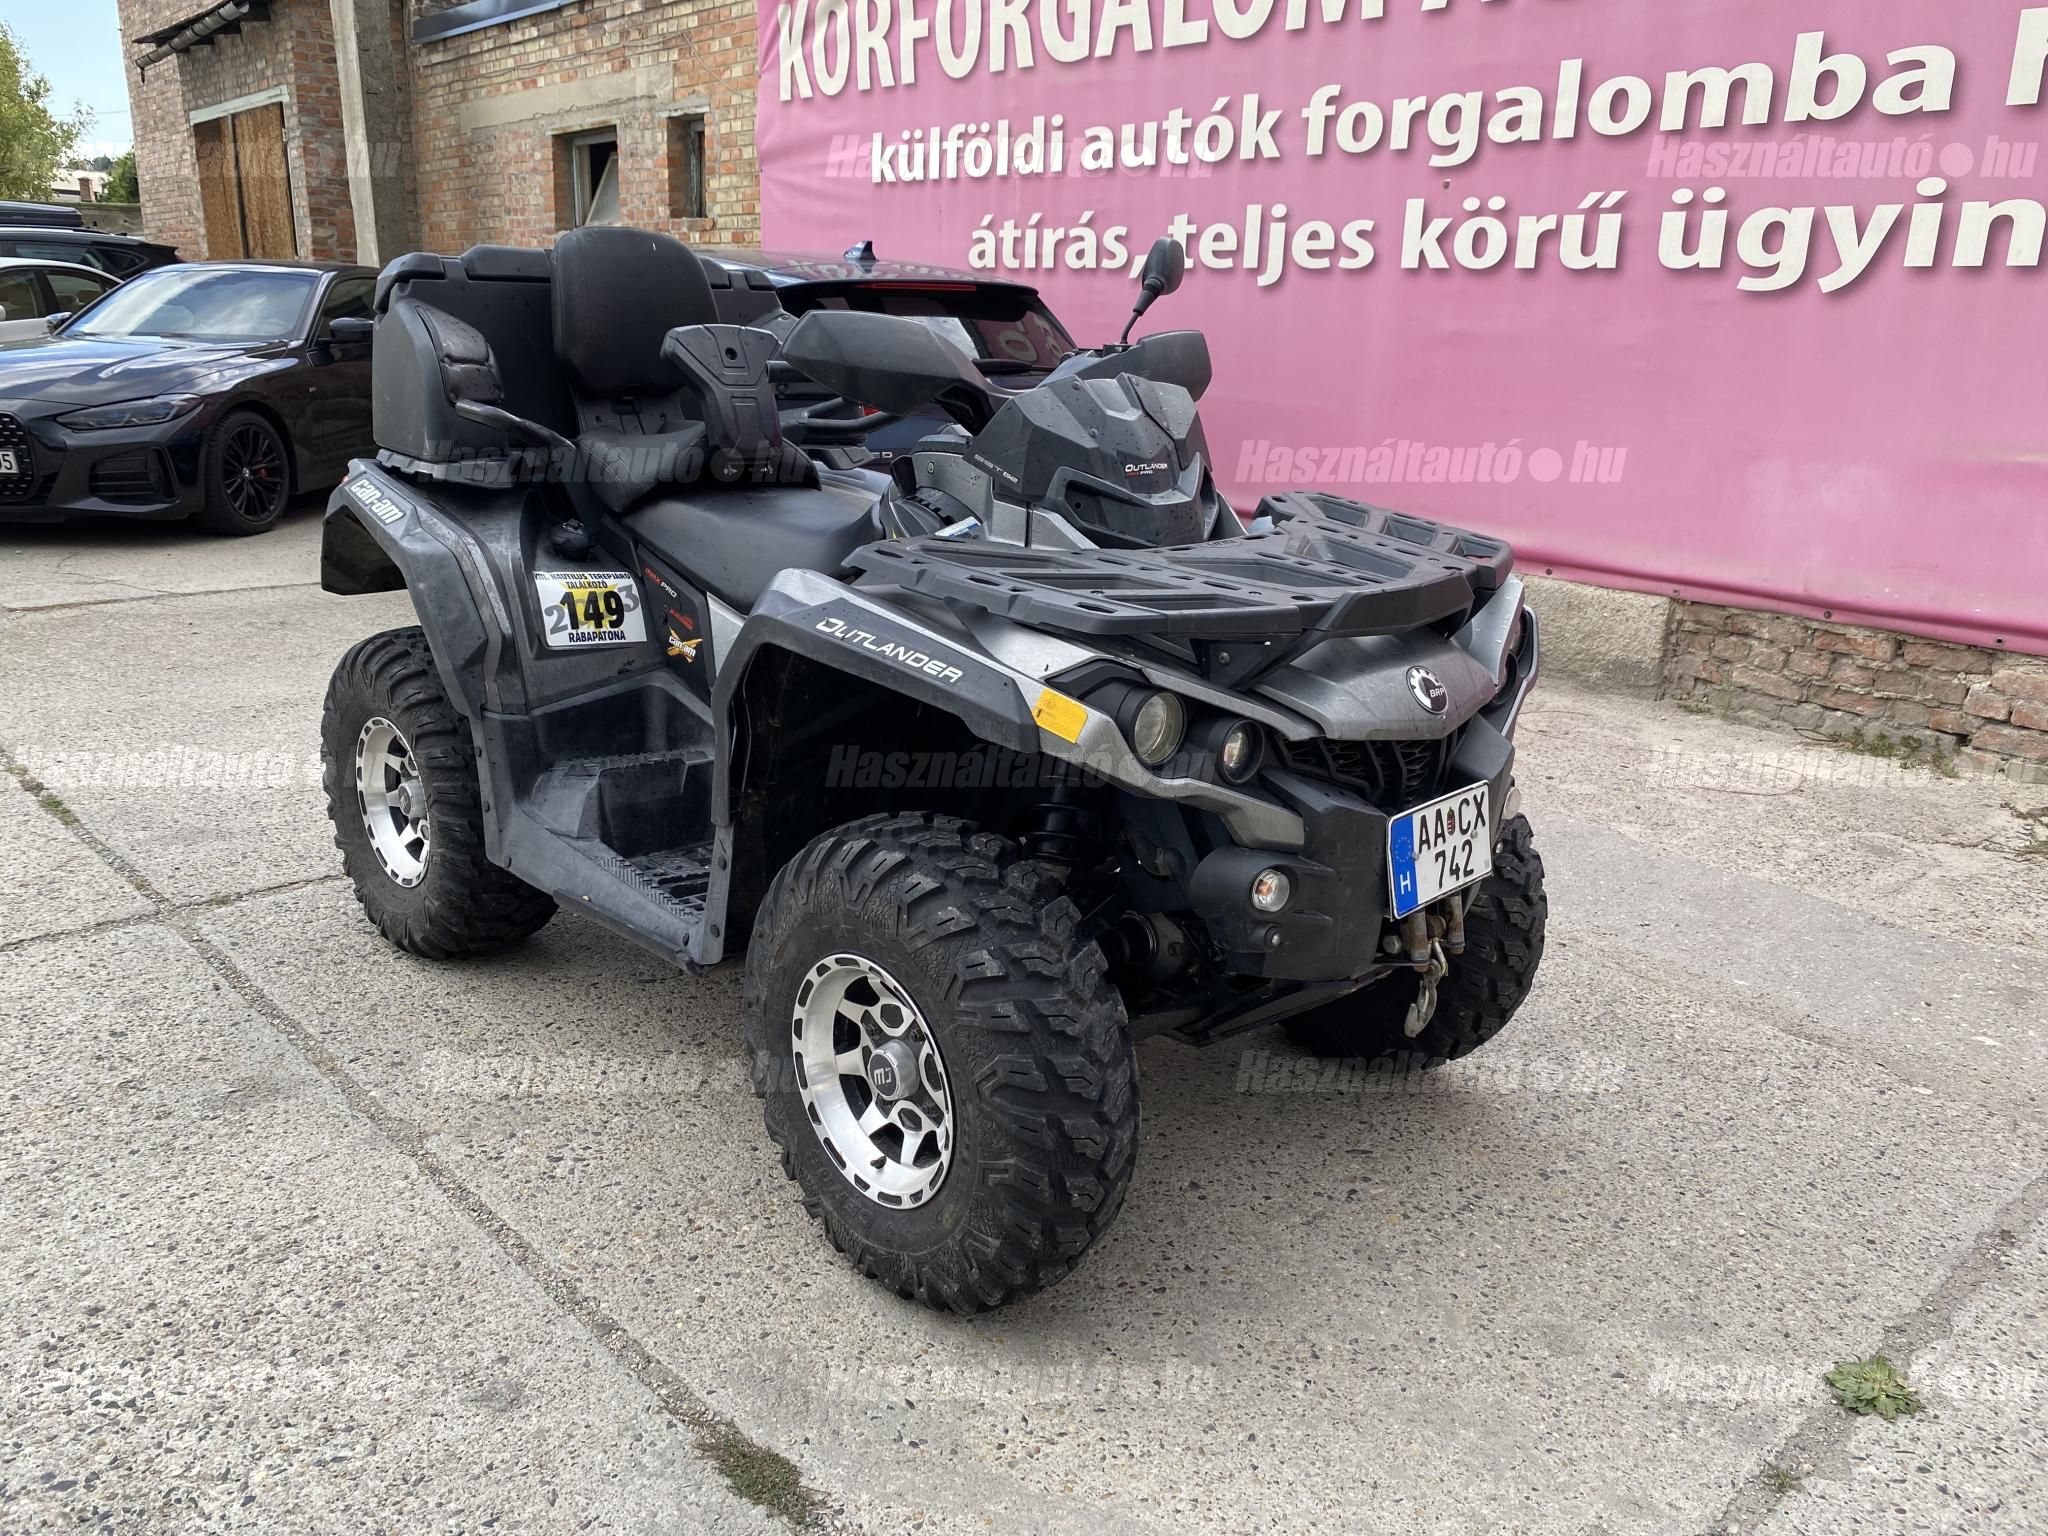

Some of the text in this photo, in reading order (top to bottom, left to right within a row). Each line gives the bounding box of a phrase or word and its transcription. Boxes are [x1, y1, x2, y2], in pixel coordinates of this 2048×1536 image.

[870, 113, 1065, 184] külföldi
[1079, 87, 1284, 171] autók
[1301, 31, 1956, 168] forgalomba
[968, 177, 2048, 294] átírás, teljes körű ügyin
[0, 453, 13, 471] 5
[351, 479, 404, 524] can-am
[560, 591, 625, 630] 149
[816, 616, 963, 683] OUTLANDER
[1429, 687, 1445, 698] BRP
[1418, 791, 1487, 854] AA CX
[1399, 871, 1412, 895] H
[1434, 840, 1475, 890] 742
